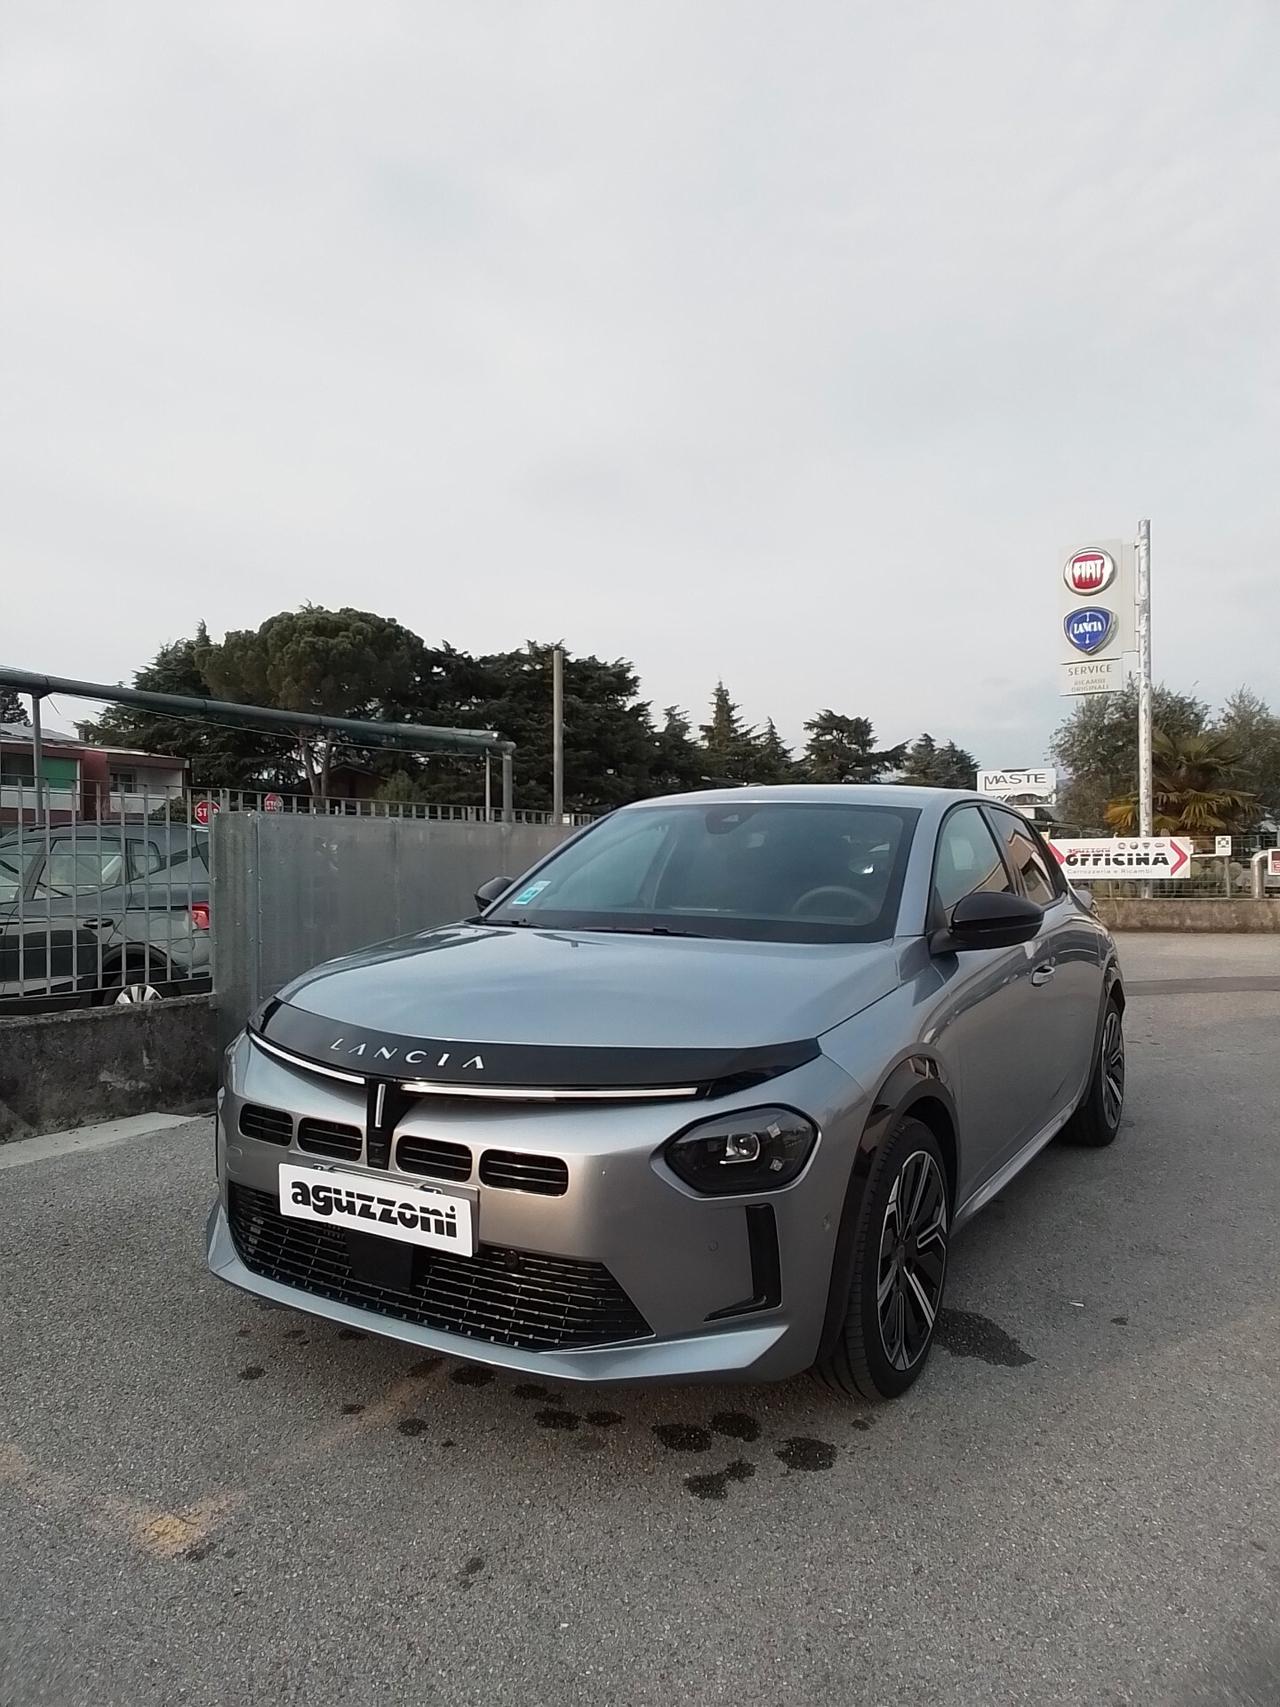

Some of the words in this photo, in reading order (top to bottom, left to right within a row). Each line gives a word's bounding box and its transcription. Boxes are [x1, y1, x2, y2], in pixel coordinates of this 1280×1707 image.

[1073, 560, 1104, 582] FIAT
[1074, 621, 1102, 634] LANCIA
[1068, 664, 1112, 676] SERVICE
[197, 808, 218, 817] STP
[1065, 853, 1169, 866] OFFICINA
[330, 1038, 485, 1069] LANCIA
[291, 1181, 457, 1237] aguzzoni
